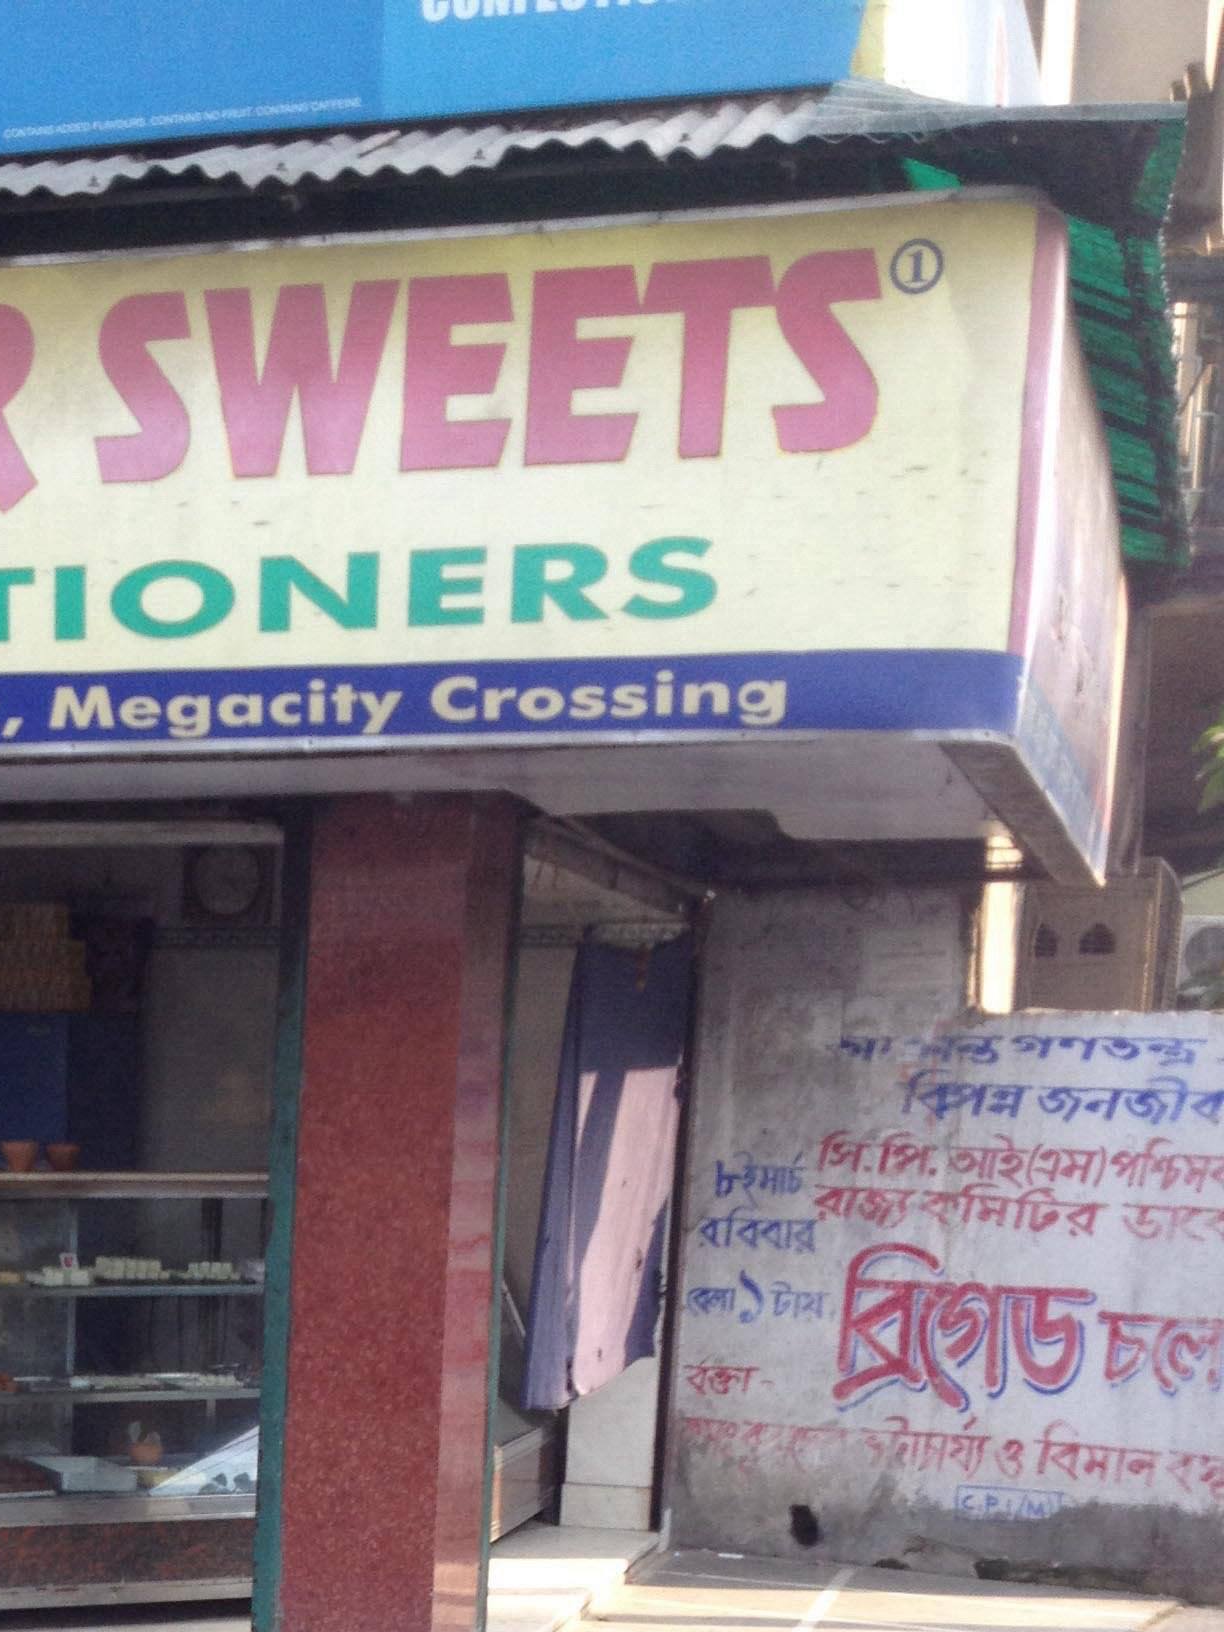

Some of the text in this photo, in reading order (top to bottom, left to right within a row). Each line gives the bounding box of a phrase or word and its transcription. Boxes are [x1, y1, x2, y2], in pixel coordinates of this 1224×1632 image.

[94, 249, 882, 484] SWEETS
[49, 680, 402, 739] Megacity
[431, 671, 788, 728] Crossing
[831, 1241, 1097, 1414] ব্রিগেড
